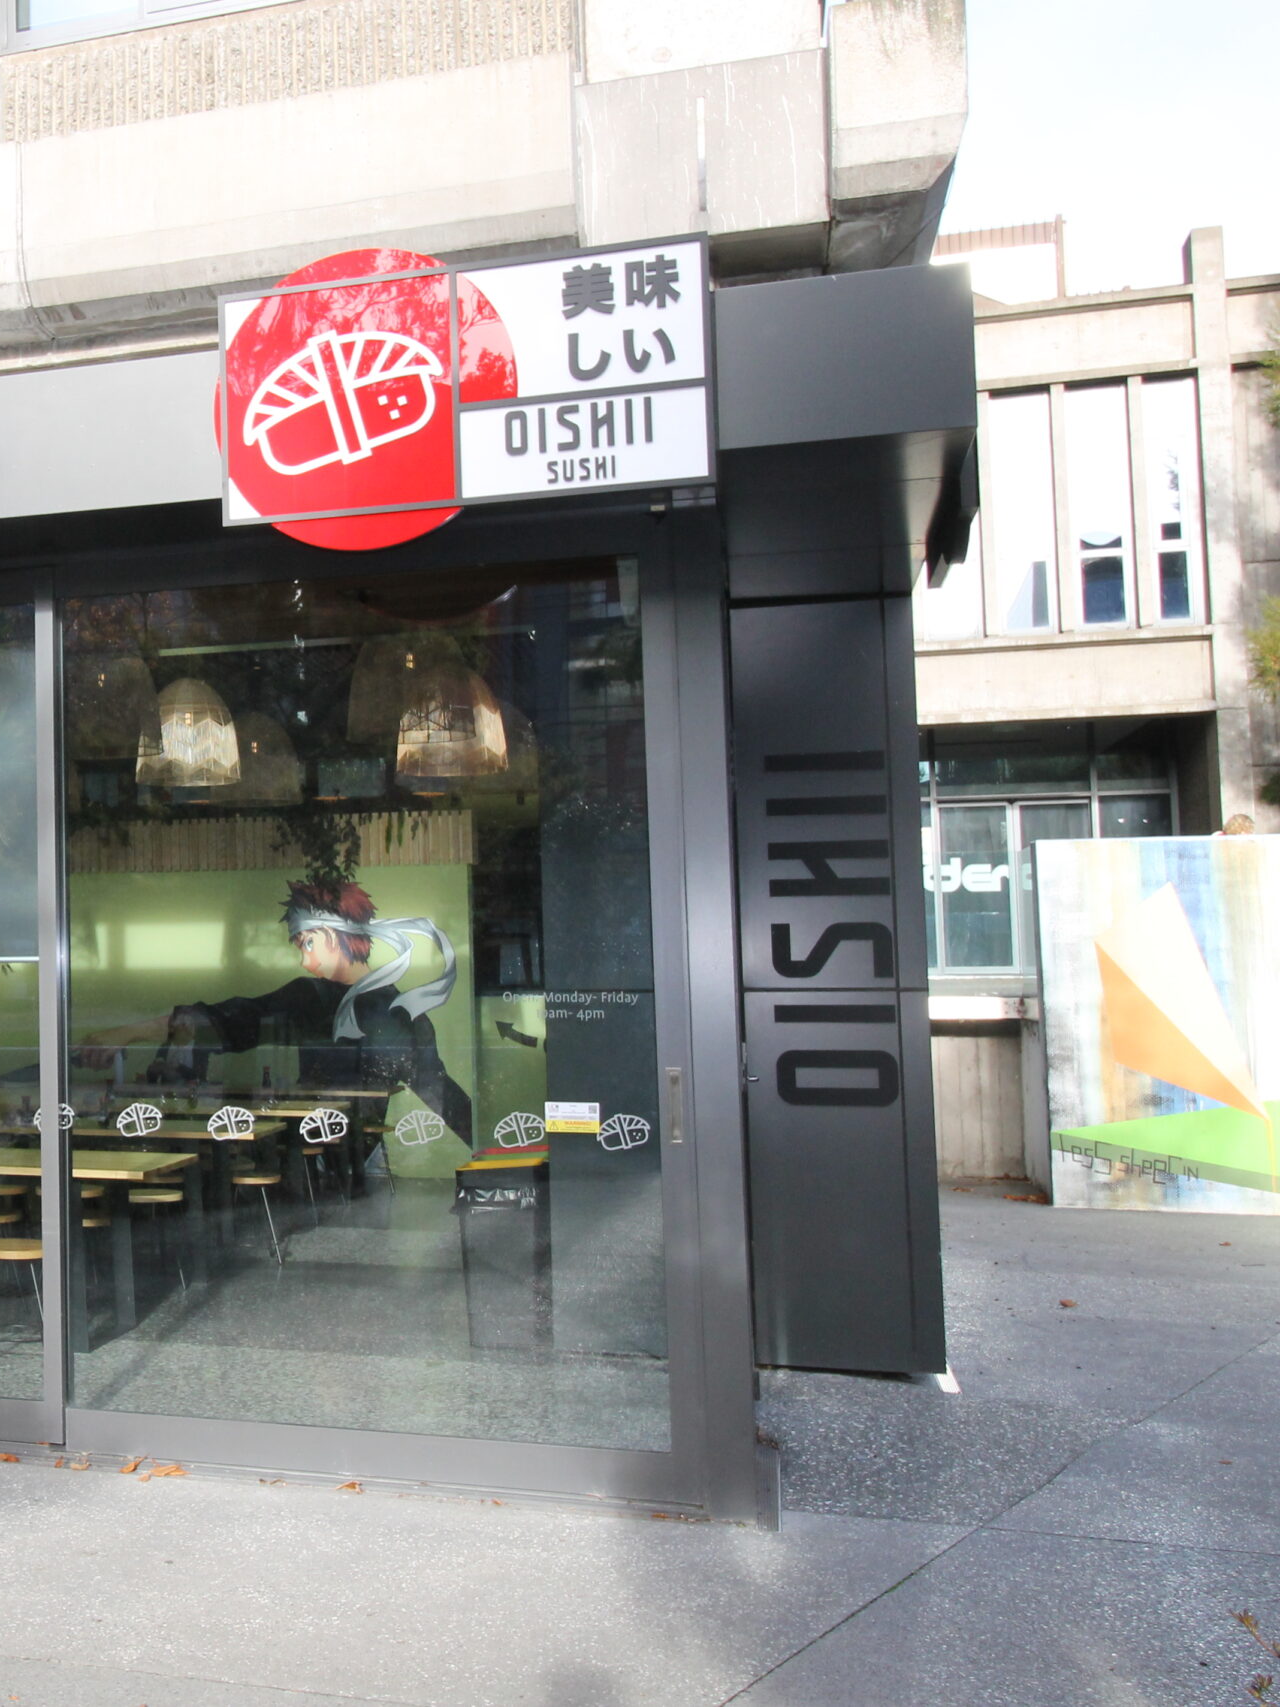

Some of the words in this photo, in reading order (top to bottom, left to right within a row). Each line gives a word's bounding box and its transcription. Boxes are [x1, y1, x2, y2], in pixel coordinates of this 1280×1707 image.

[562, 254, 681, 320] 美味
[568, 328, 676, 381] しい
[505, 396, 653, 456] OISHII
[547, 455, 616, 484] SUSHI
[764, 750, 899, 1107] OISHII
[576, 1008, 605, 1021] 4pm
[601, 991, 639, 1006] Friday
